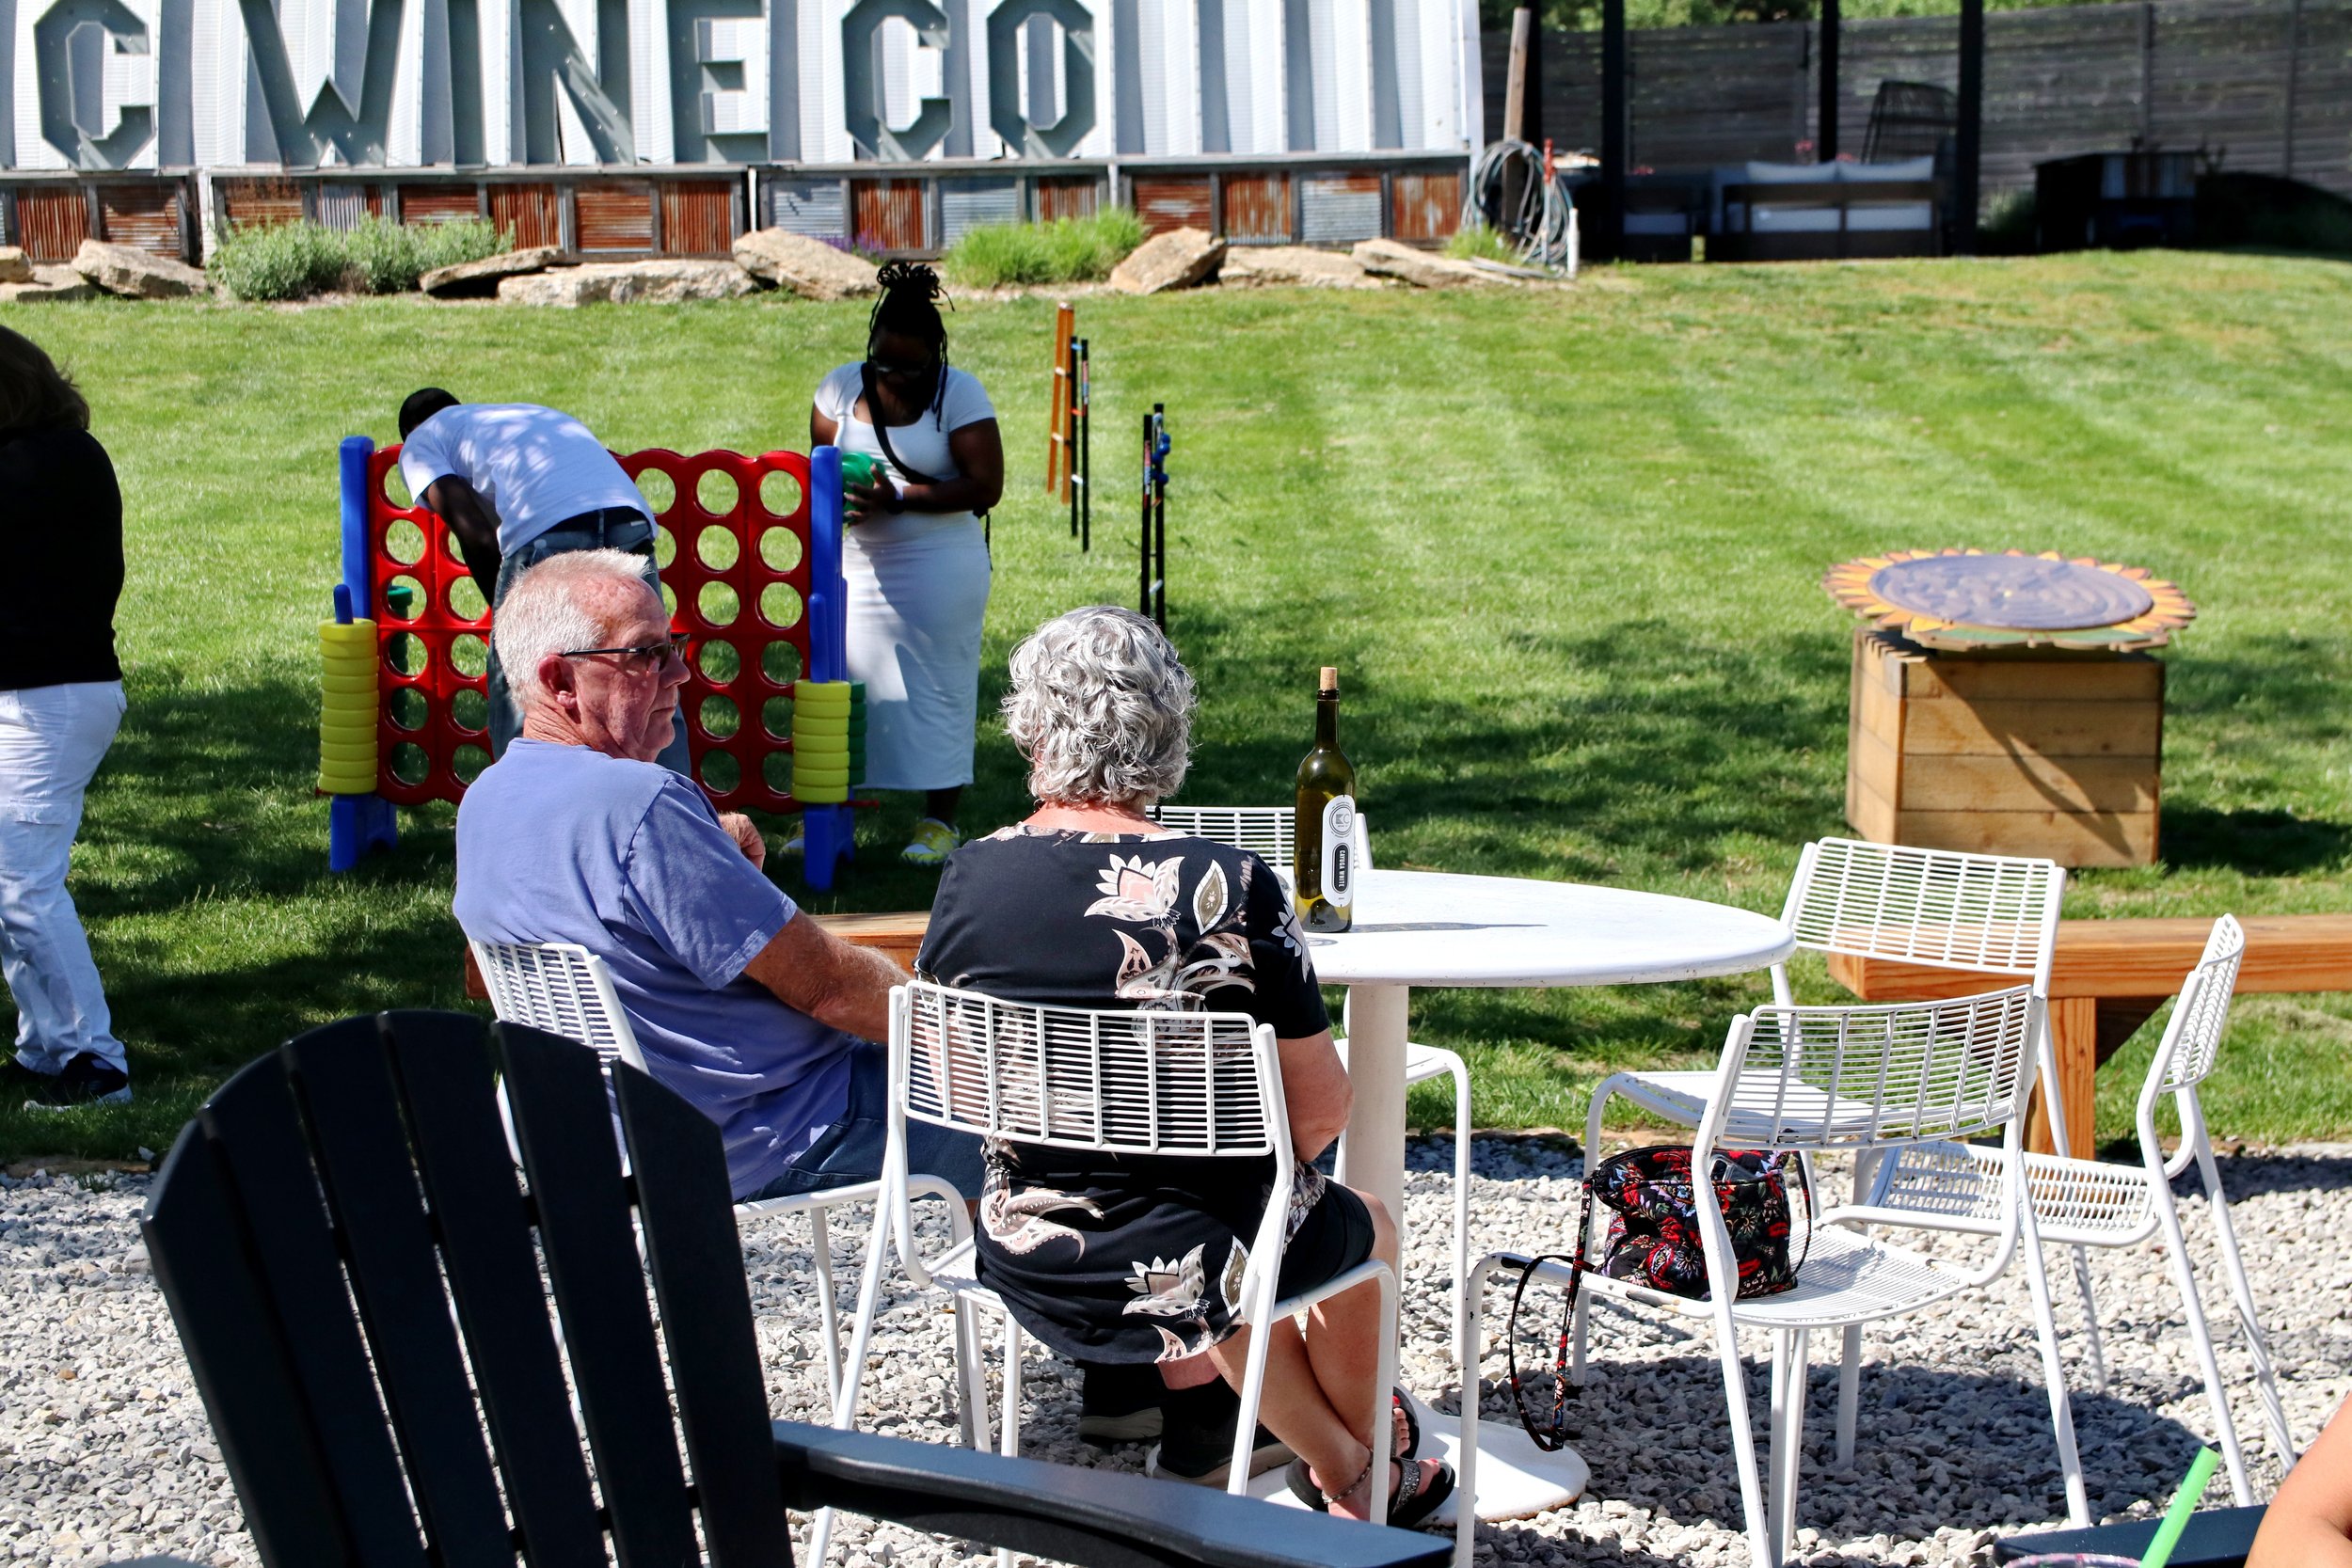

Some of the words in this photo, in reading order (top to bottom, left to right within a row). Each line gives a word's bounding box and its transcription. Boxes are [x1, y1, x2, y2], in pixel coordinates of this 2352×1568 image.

[34, 0, 157, 170] C
[238, 0, 771, 167] WINE
[842, 0, 1097, 161] CO
